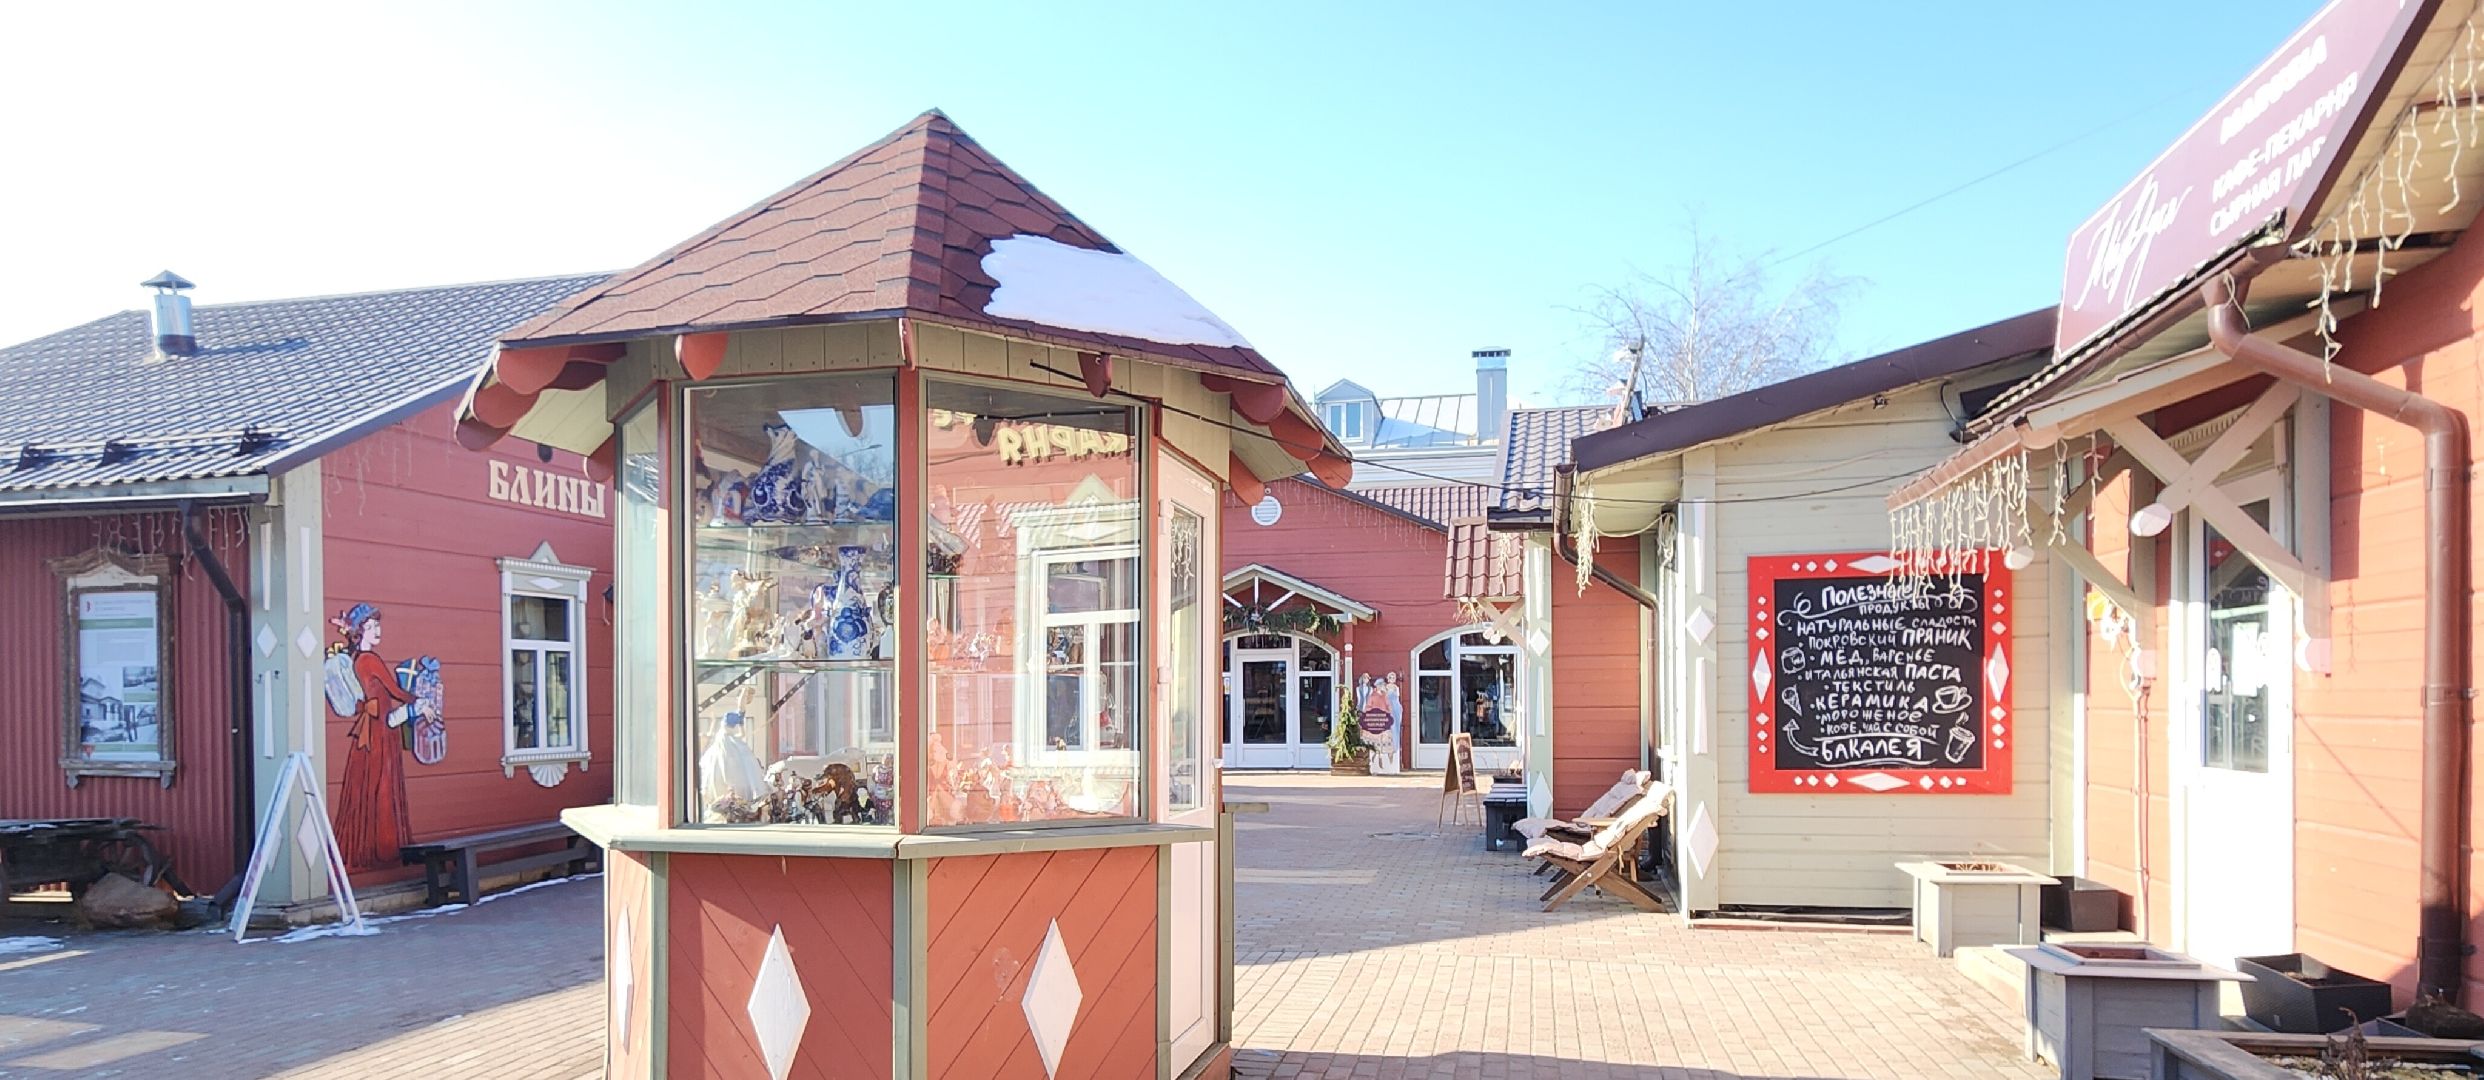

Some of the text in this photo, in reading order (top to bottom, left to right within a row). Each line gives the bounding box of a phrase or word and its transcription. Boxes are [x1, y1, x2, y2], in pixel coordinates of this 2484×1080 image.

[2210, 167, 2281, 237] СЫРНАЯ
[489, 459, 606, 519] БЛИНЫ
[1797, 615, 1977, 637] НАТУРАЛЬНЫЕ СЛАДОСТИ
[1808, 627, 1973, 651] ПОКРОВСКИЙ ПРЯНИК
[1820, 645, 1936, 667] МЁД, ВАРЕНЬЕ
[1805, 663, 1962, 683] ИТАЛЬЯНСКАЯ ПАСТА
[1832, 680, 1916, 694] ТЕКСТИЛЬ
[1816, 693, 1928, 714] КЕРАМИКА
[1895, 723, 1940, 739] СОБОЙ
[1822, 738, 1922, 761] БАКАЛЕЯ
